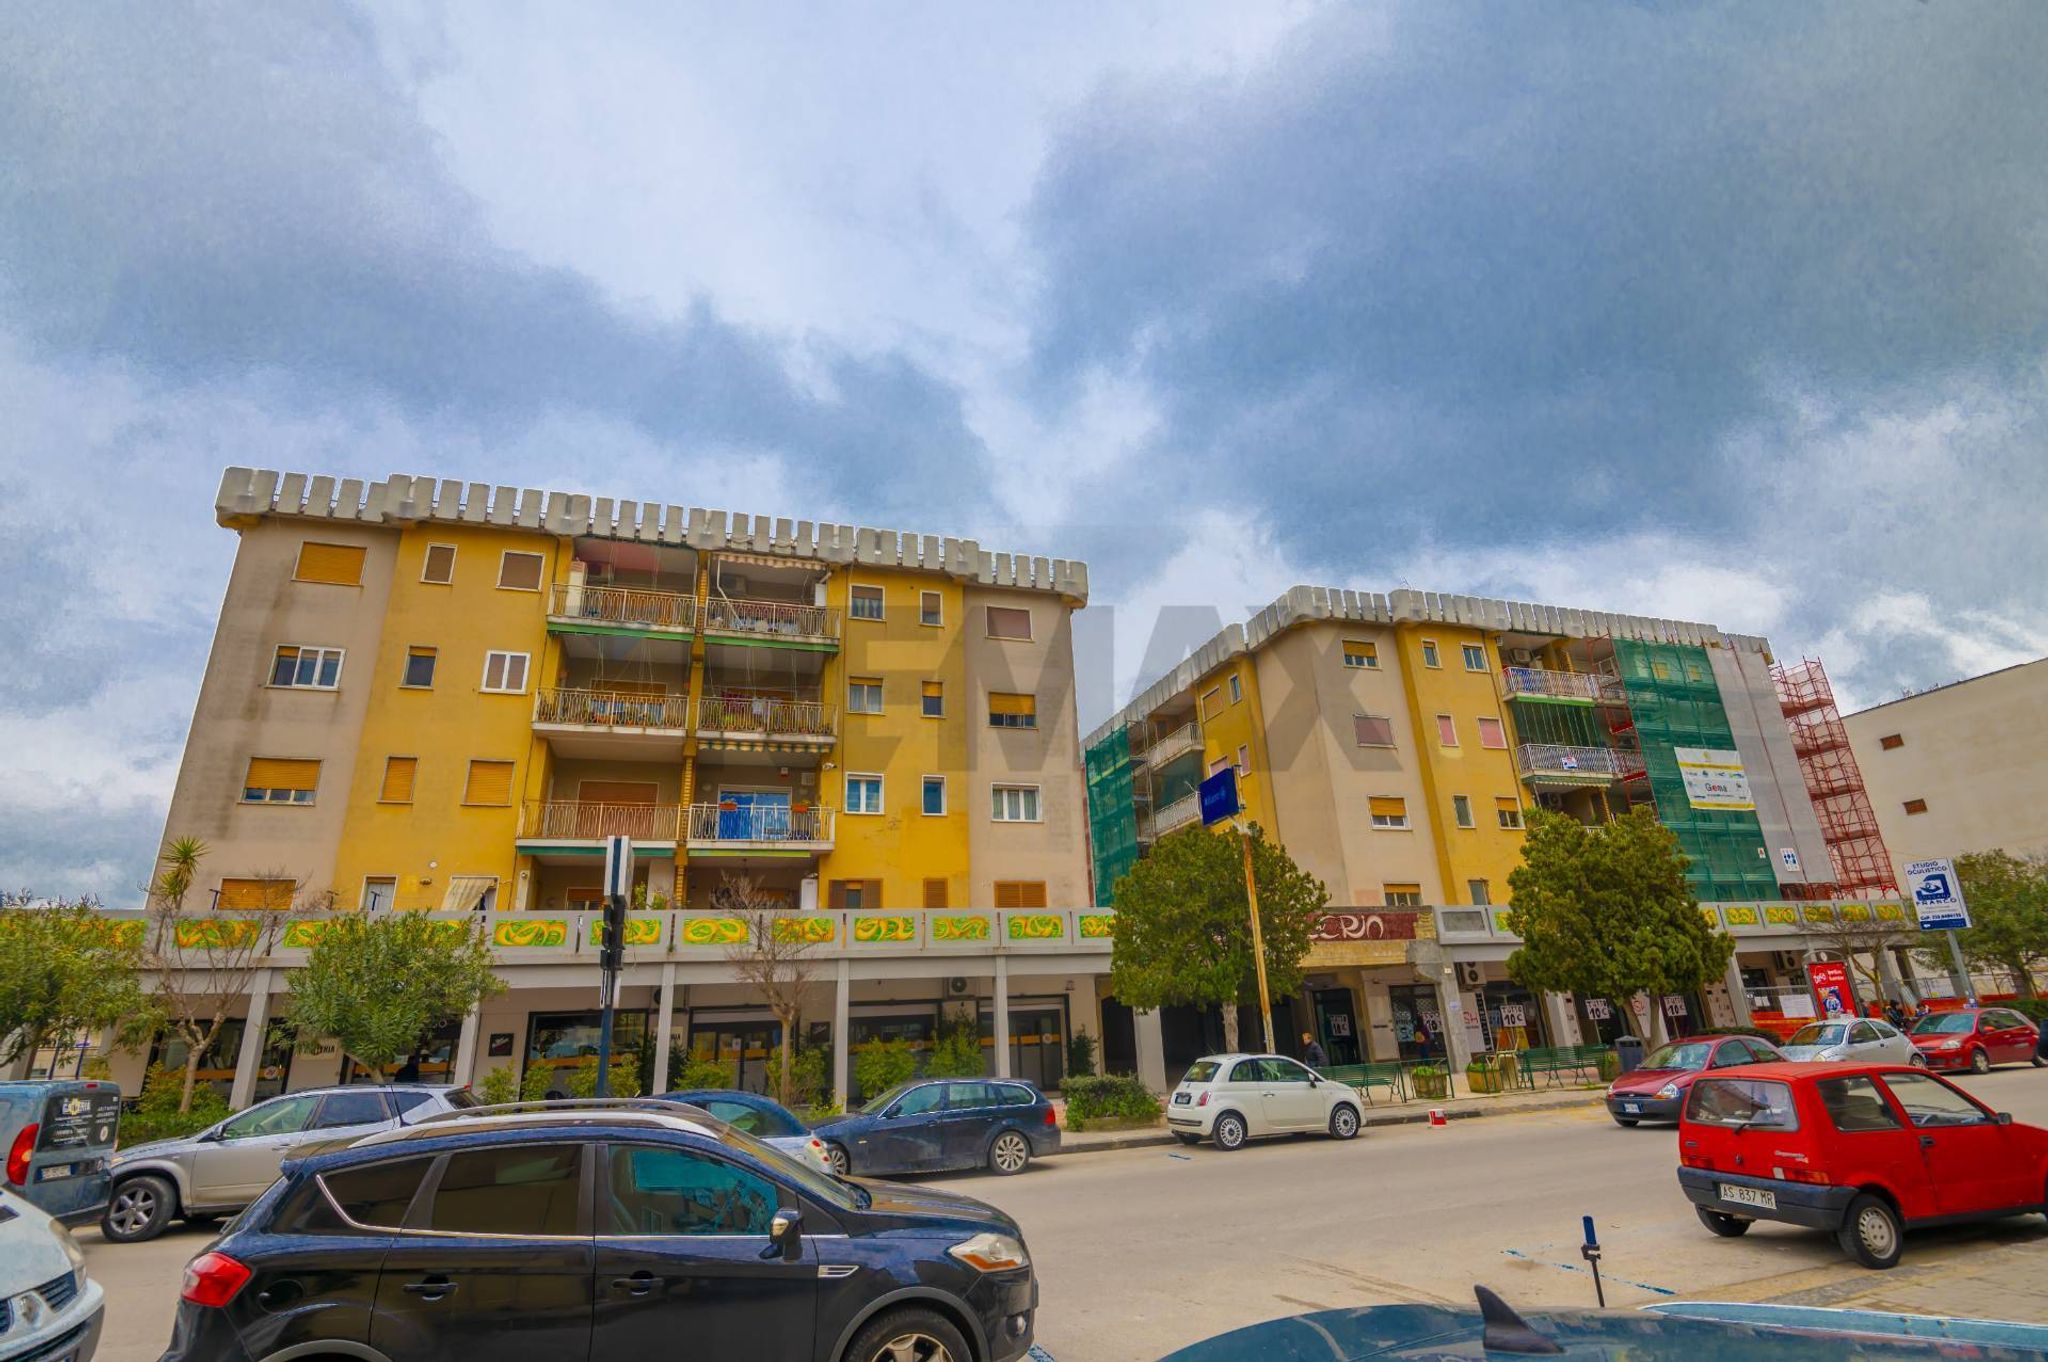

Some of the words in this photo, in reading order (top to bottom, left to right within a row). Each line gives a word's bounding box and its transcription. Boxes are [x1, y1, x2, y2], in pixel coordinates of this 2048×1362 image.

[1907, 865, 1947, 875] OCULISTICO
[1589, 1007, 1601, 1018] 10
[1504, 1014, 1516, 1025] 10
[1723, 1186, 1734, 1198] AS
[1739, 1188, 1756, 1202] 837
[1760, 1191, 1773, 1206] MR
